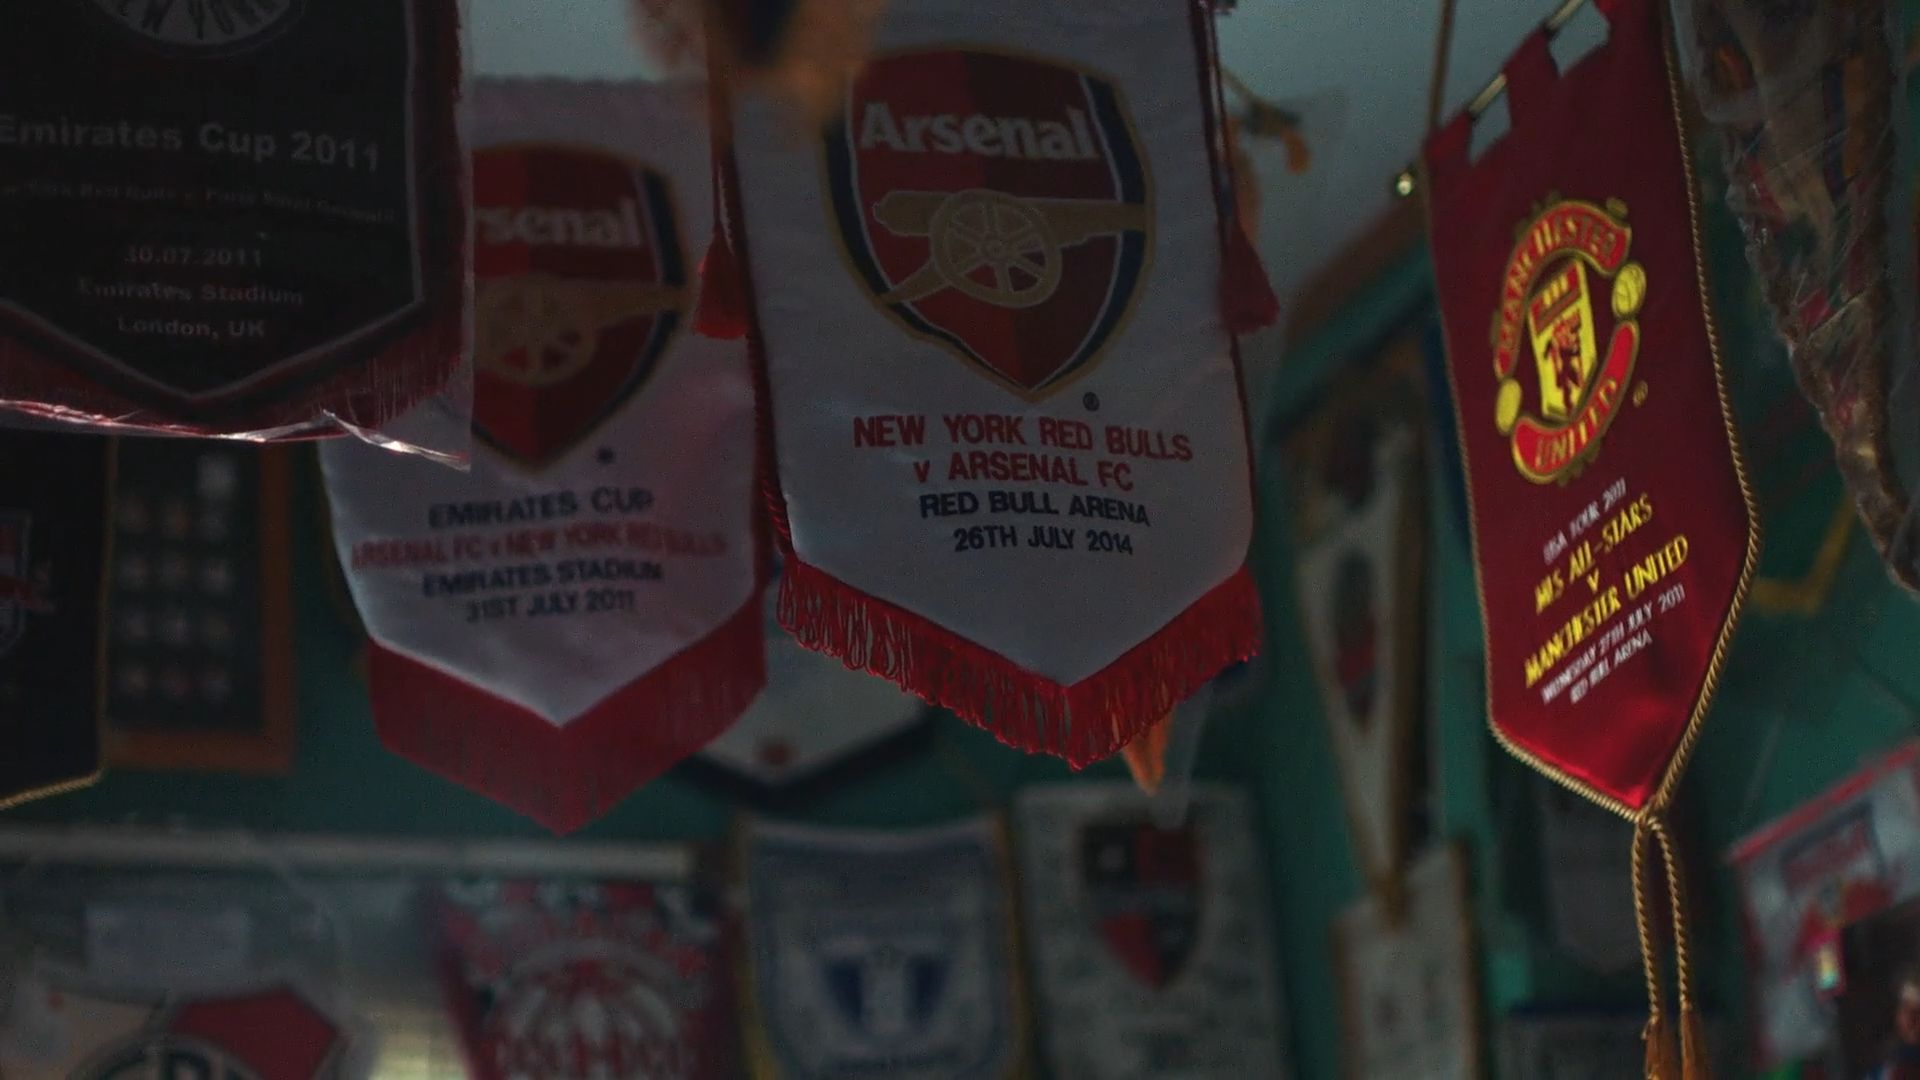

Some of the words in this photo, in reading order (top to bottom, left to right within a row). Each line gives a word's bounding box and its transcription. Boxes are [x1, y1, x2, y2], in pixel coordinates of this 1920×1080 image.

[0, 114, 183, 151] Emirates
[198, 122, 277, 162] Cup
[290, 131, 380, 173] 2011
[861, 102, 1102, 160] Arsenal
[474, 197, 642, 247] senal
[200, 281, 303, 305] Stadium
[116, 315, 220, 341] London,
[228, 319, 266, 338] UK
[852, 414, 926, 448] NEW
[942, 414, 1027, 446] YORK
[1038, 415, 1093, 450] RED
[1104, 425, 1195, 462] BULLS
[947, 450, 1090, 487] ARSENAL
[1097, 460, 1135, 492] FC
[427, 490, 578, 530] EMIRATES
[591, 486, 655, 513] CUP
[918, 491, 980, 519] RED
[988, 490, 1060, 516] BULL
[1068, 495, 1151, 528] ARENA
[953, 524, 1018, 552] 26TH
[1027, 525, 1077, 550] JULY
[1086, 529, 1134, 555] 2014
[422, 560, 553, 598] EMIRATES
[557, 556, 664, 585] STADIUM
[526, 591, 579, 617] JULY
[585, 589, 636, 613] 2011
[1523, 584, 1622, 690] MANCHESTER
[1623, 532, 1691, 602] UNITED
